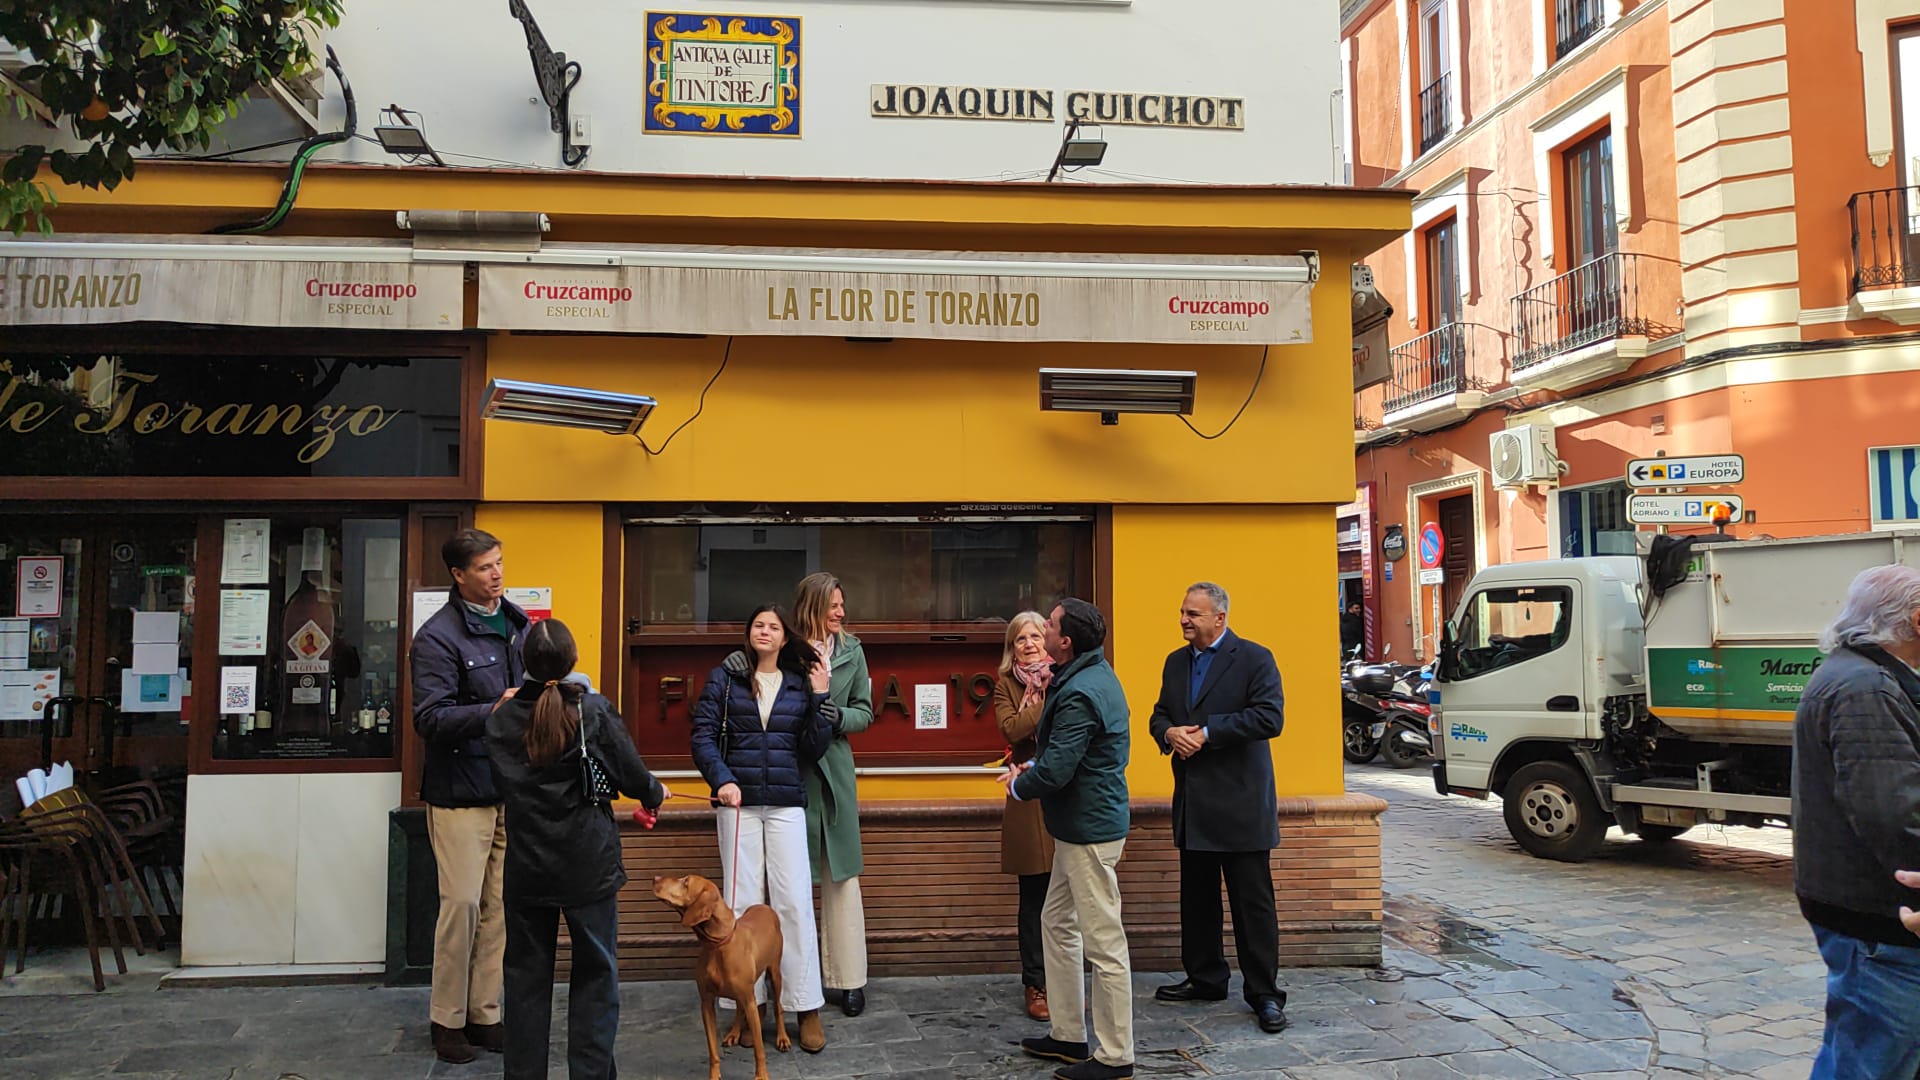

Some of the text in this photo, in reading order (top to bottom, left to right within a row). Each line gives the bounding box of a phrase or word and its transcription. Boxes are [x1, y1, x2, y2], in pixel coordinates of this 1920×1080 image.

[714, 66, 733, 77] DE
[675, 79, 773, 103] TINTORES
[873, 86, 1242, 126] JOAQUIN GUICHOT
[17, 272, 141, 308] TORANZO
[305, 278, 416, 301] Cruzcampo
[524, 280, 632, 304] Cruzcampo
[327, 302, 393, 316] ESPECIAL
[546, 306, 610, 318] ESPECIAL
[768, 287, 1040, 327] LA FLOR DE TORANZO
[1168, 296, 1269, 318] Cruzcampo
[1190, 320, 1248, 331] ESPECIAL
[75, 370, 402, 463] Toranzo
[1690, 469, 1740, 478] EUROPA
[1766, 682, 1804, 692] Servicio
